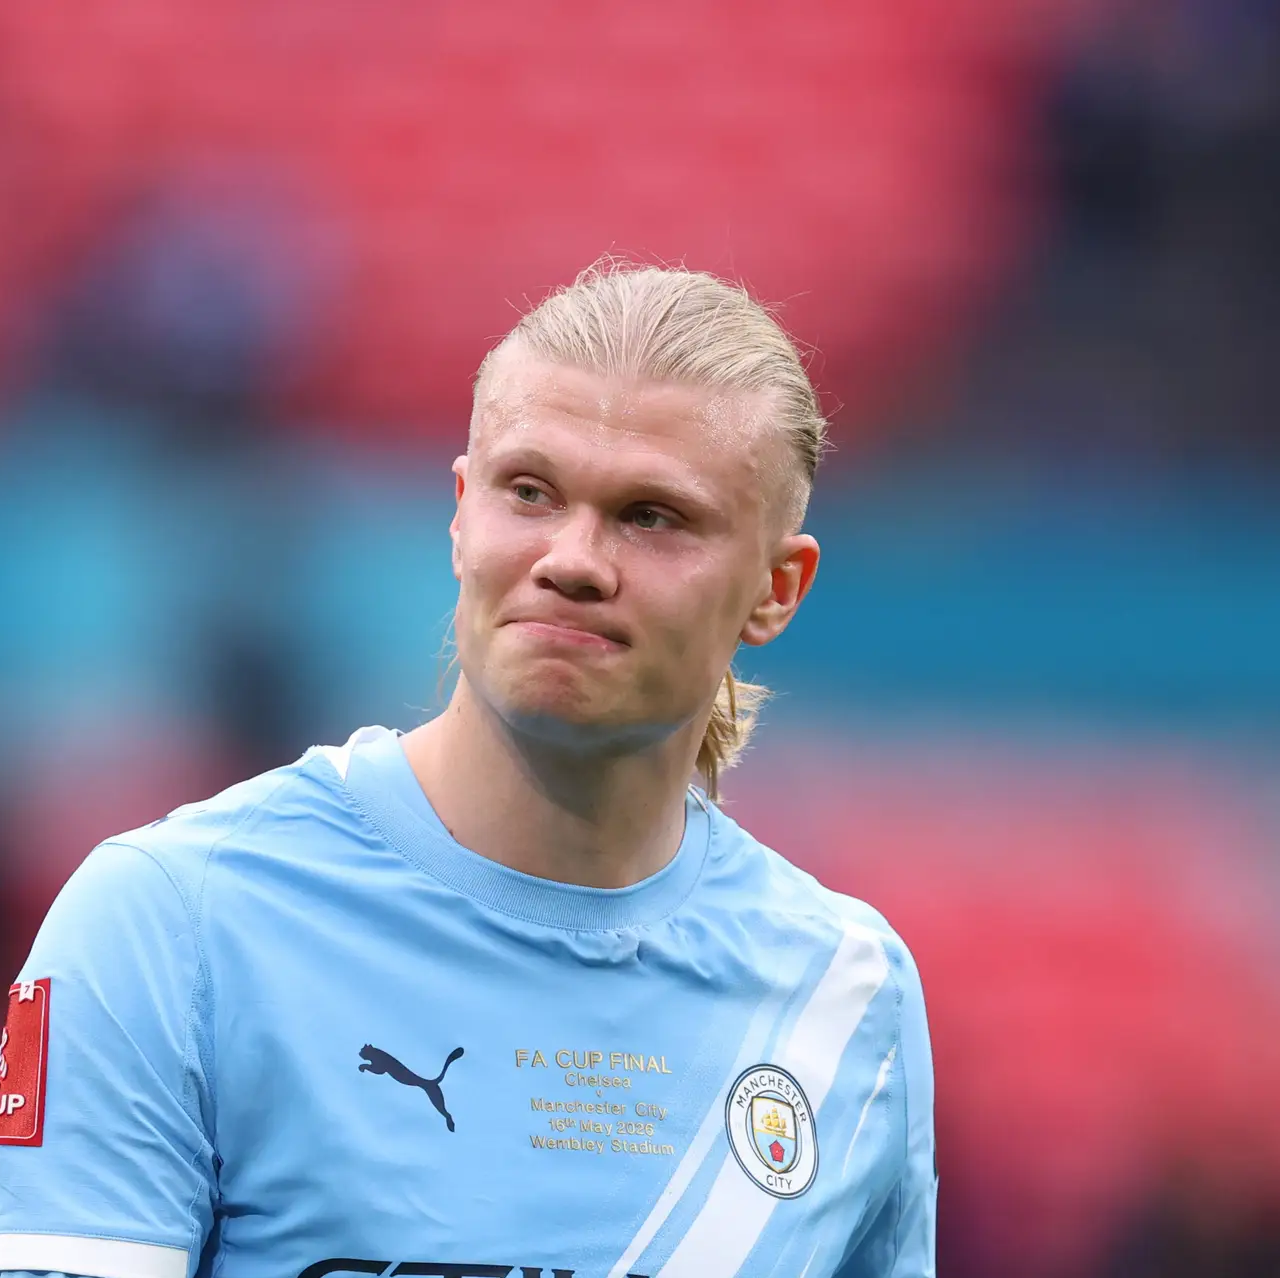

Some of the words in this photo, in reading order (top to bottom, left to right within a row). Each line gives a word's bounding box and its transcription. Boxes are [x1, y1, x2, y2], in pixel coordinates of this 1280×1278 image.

[515, 1049, 548, 1068] FA
[555, 1049, 603, 1069] CUP
[609, 1052, 673, 1074] FINAL
[565, 1072, 632, 1088] Chelsea
[531, 1098, 626, 1115] Manchester
[635, 1102, 668, 1120] City
[736, 1075, 807, 1123] MANCHESTER
[548, 1118, 576, 1132] 16th
[580, 1120, 612, 1136] May
[617, 1121, 655, 1136] 2026
[530, 1136, 604, 1154] Wembley
[611, 1138, 674, 1156] Stadium
[766, 1174, 793, 1190] CITY
